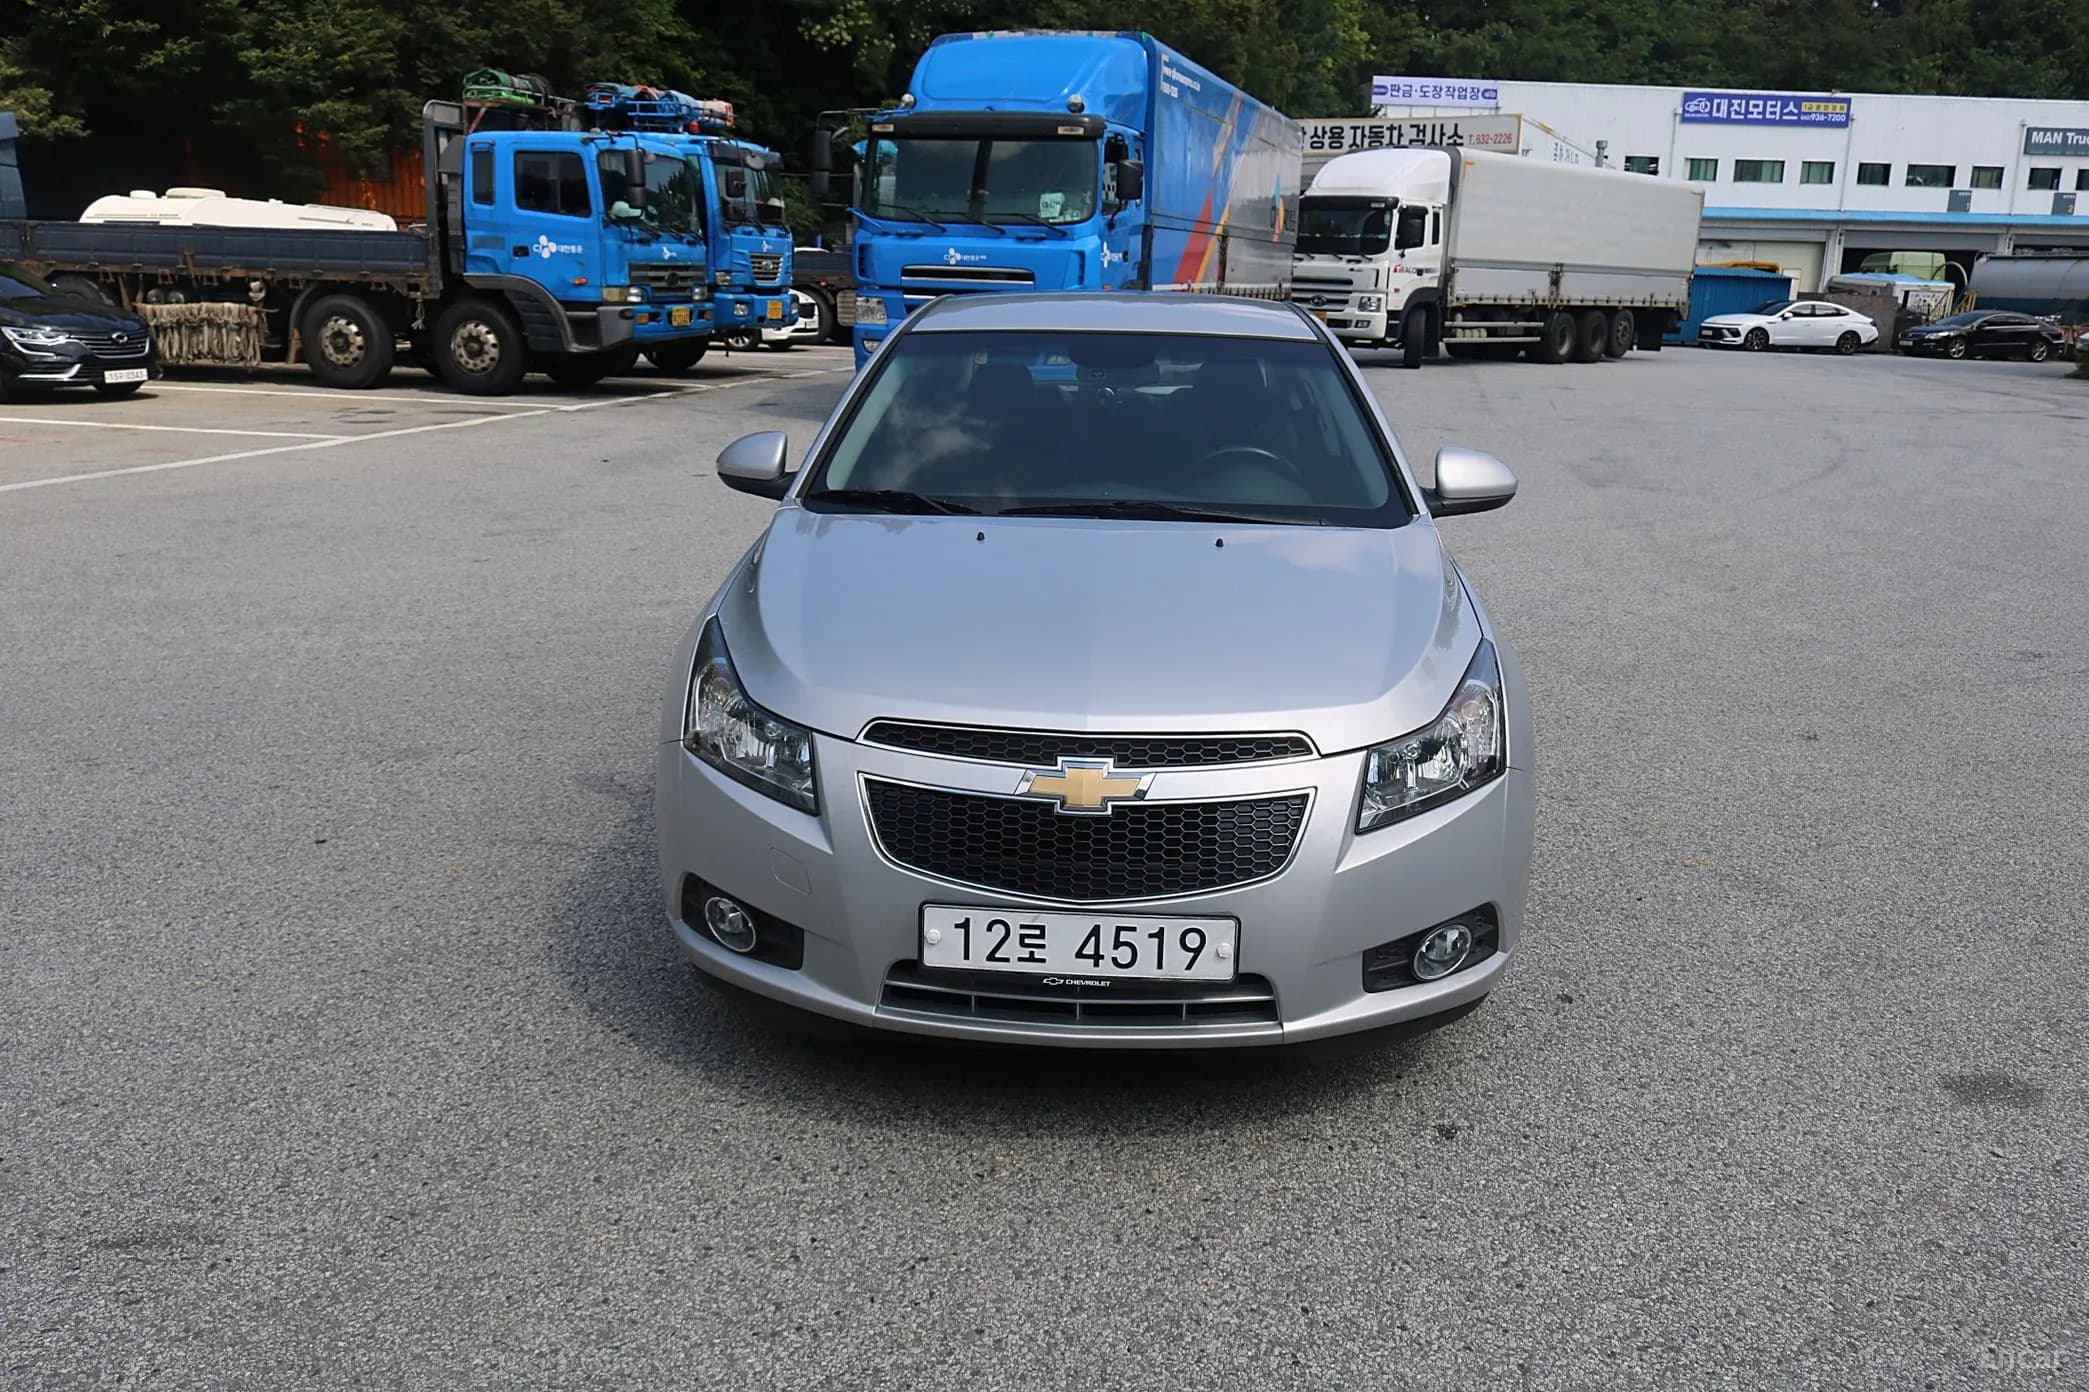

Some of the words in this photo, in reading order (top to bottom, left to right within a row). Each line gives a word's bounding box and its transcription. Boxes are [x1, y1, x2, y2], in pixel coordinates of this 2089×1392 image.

[1712, 98, 1799, 121] 대진모터스
[1310, 124, 1345, 150] 상용
[1350, 123, 1404, 149] 자동차
[1408, 122, 1464, 148] 검사소
[2031, 131, 2063, 144] MAN
[954, 916, 1047, 964] 12로
[1074, 923, 1208, 971] 4519
[1066, 978, 1111, 988] CHEVROLET
